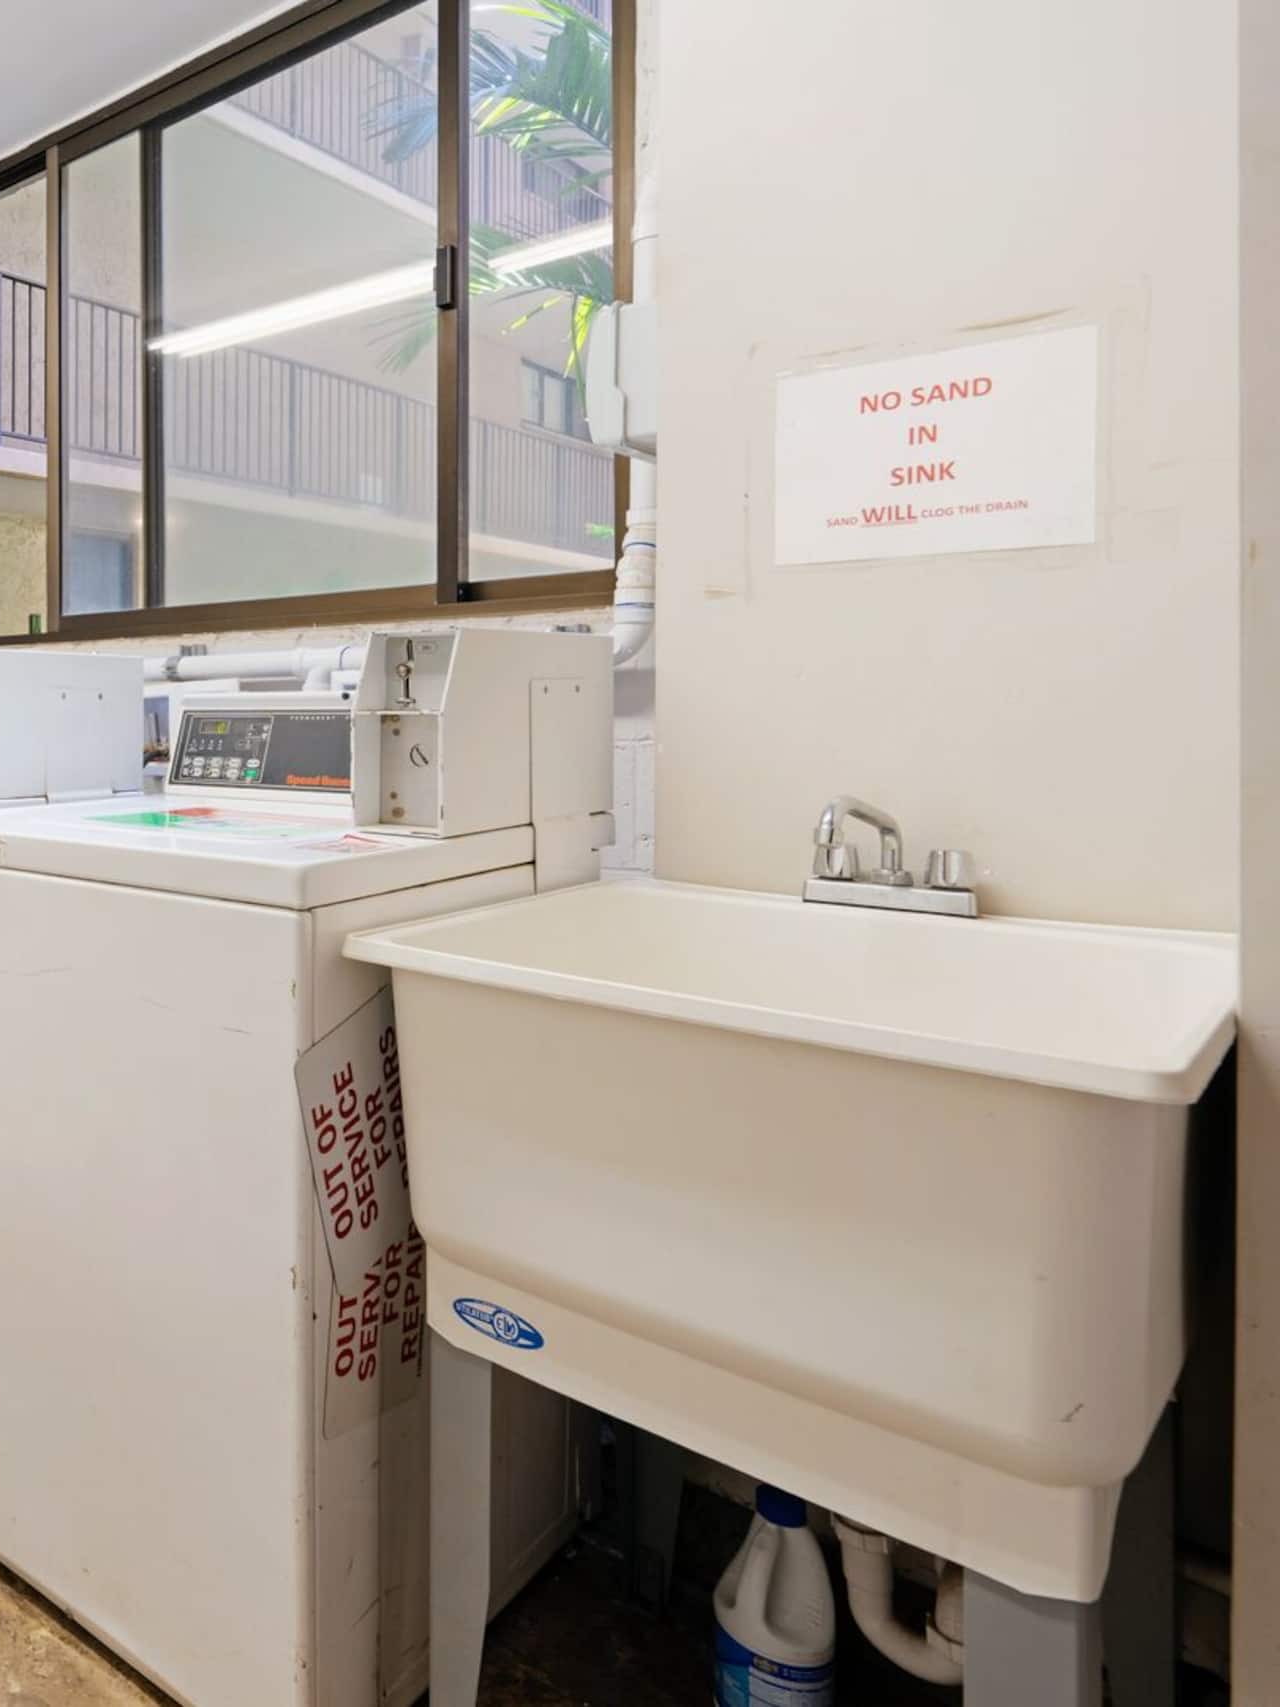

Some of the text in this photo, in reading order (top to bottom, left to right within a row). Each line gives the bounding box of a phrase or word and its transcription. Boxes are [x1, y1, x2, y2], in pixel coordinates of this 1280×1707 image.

[859, 377, 993, 414] NO SAND
[908, 424, 938, 446] IN
[826, 499, 1029, 528] SAND WILL CLOG THE DRAIN
[889, 461, 956, 487] SINK
[332, 1061, 379, 1230] SERVICE
[364, 1086, 392, 1170] FOR
[379, 1026, 409, 1190] EPAIRS
[311, 1104, 354, 1239] OUT OF
[358, 1256, 383, 1382] SERV
[382, 1241, 404, 1325] FOR
[335, 1295, 358, 1377] OUT
